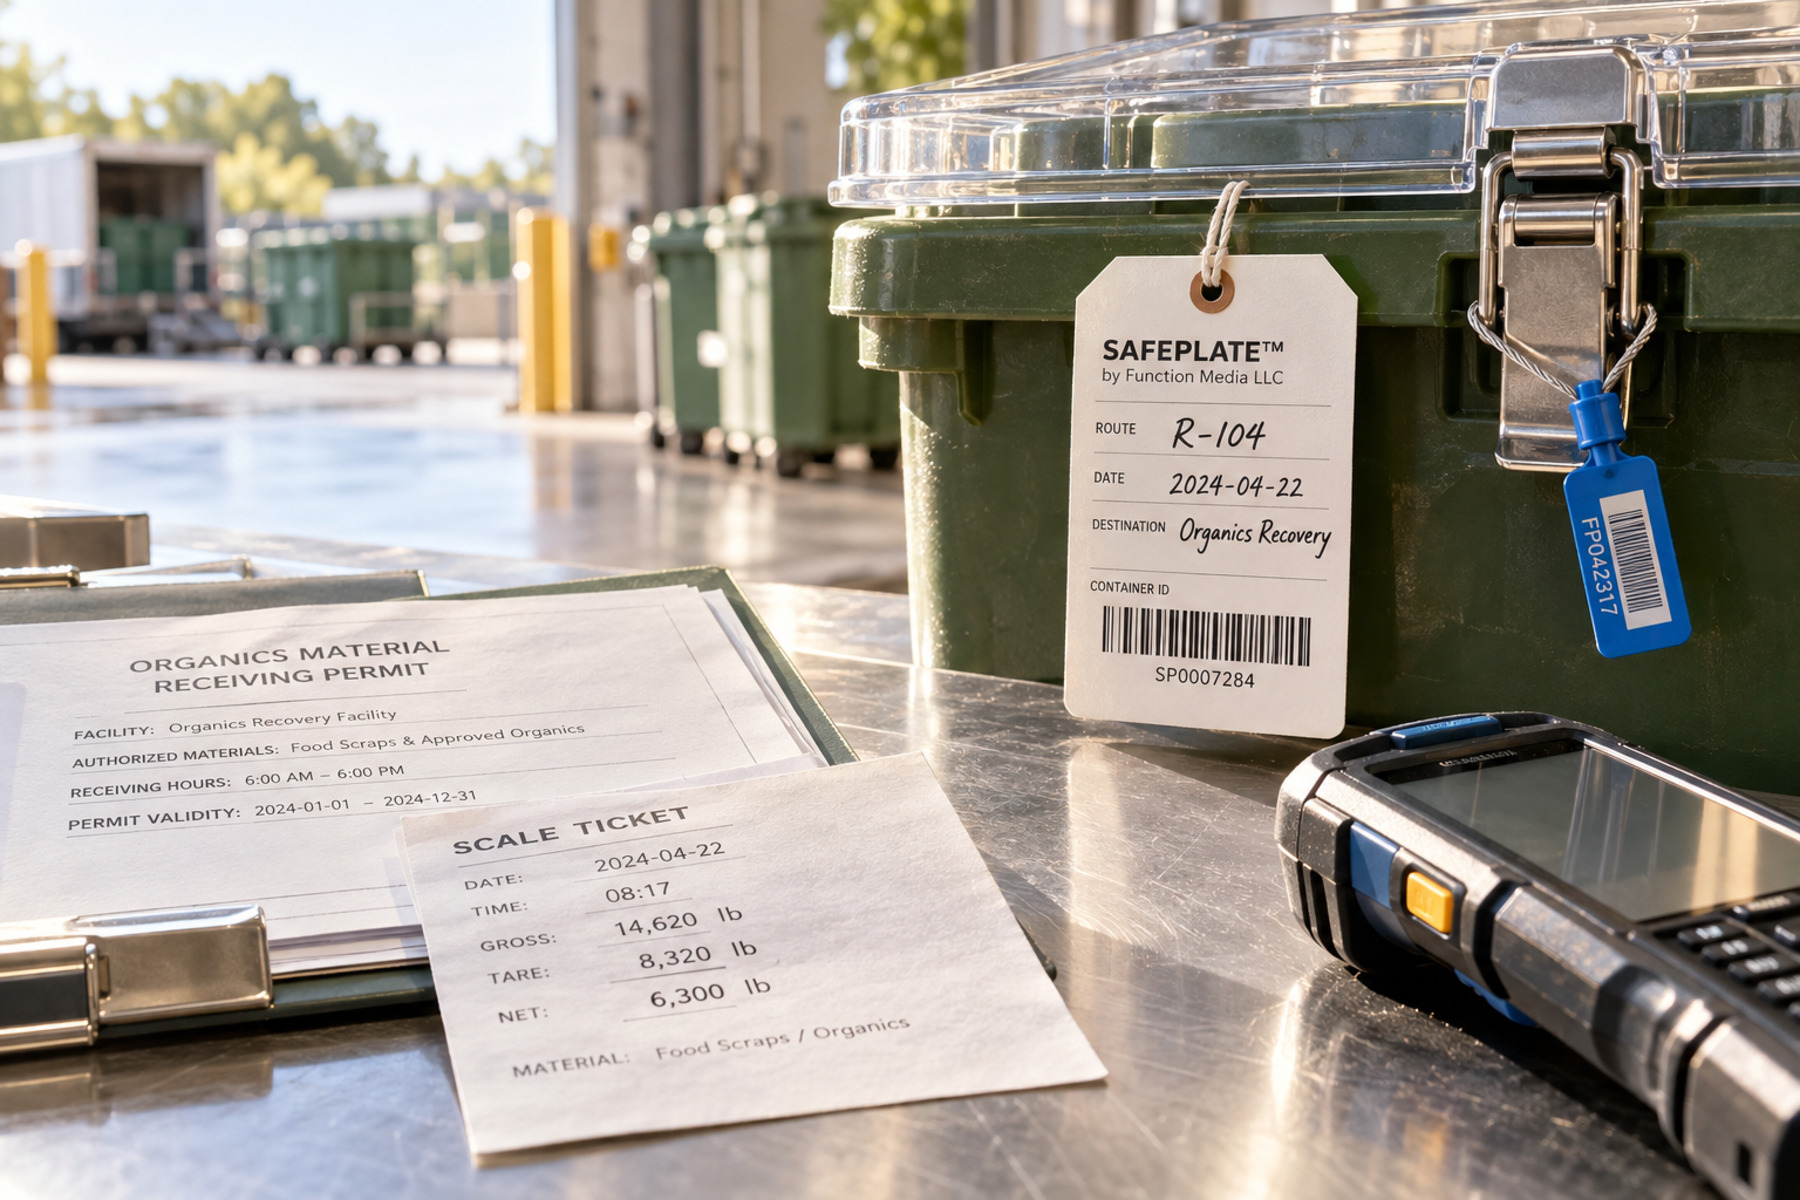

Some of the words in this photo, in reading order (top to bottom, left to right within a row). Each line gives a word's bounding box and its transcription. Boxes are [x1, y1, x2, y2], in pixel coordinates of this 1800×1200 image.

[1102, 368, 1120, 385] by
[1126, 368, 1194, 383] Function
[1200, 370, 1248, 384] Media
[1254, 370, 1283, 385] LLC
[1096, 422, 1136, 435] ROUTE
[1172, 417, 1266, 450] R-104
[1094, 471, 1125, 484] DATE
[1169, 473, 1303, 497] 2024-04-22
[1093, 519, 1165, 532] DESTINATION
[1180, 518, 1253, 554] Organics
[1258, 519, 1332, 559] Recovery
[1582, 517, 1618, 615] FP042317
[1090, 580, 1154, 594] CONTAINER
[1159, 584, 1169, 595] ID
[130, 649, 288, 673] ORGANICS
[300, 640, 450, 660] MATERIAL
[155, 670, 313, 693] RECEIVING
[323, 662, 429, 681] PERMIT
[1155, 667, 1255, 688] SP0007284
[75, 726, 154, 740] FACILITY:
[169, 720, 246, 734] Organics
[252, 713, 331, 727] Recovery
[337, 710, 396, 721] Facility
[72, 752, 177, 768] AUTHORIZED
[184, 745, 278, 760] MATERIALS:
[291, 740, 333, 752] Food
[340, 739, 396, 750] Scraps
[403, 736, 415, 745] &
[422, 729, 504, 746] Approved
[511, 725, 584, 739] Organics
[71, 782, 161, 798] RECEIVING
[168, 778, 231, 793] HOURS:
[245, 773, 280, 785] 6:00
[287, 771, 313, 783] AM
[338, 767, 372, 778] 6:00
[378, 765, 404, 776] PM
[69, 815, 141, 833] PERMIT
[147, 808, 240, 824] VALIDITY:
[255, 799, 348, 816] 2024-01-01
[384, 790, 475, 806] 2024-12-31
[453, 826, 559, 854] SCALE
[573, 806, 689, 835] TICKET
[465, 874, 522, 890] DATE:
[595, 842, 725, 872] 2024-04-22
[471, 902, 527, 917] TIME:
[606, 881, 669, 903] 08:17
[480, 934, 556, 952] GROSS:
[615, 913, 698, 936] 14,620
[718, 907, 742, 922] lb
[488, 967, 549, 984] TARE:
[639, 946, 712, 972] 8,320
[731, 941, 757, 957] lb
[498, 1007, 547, 1023] NET:
[650, 984, 724, 1008] 6,300
[745, 978, 770, 995] lb
[513, 1053, 629, 1077] MATERIAL:
[656, 1042, 710, 1059] Food
[717, 1032, 791, 1051] Scraps
[798, 1029, 805, 1043] /
[813, 1016, 910, 1040] Organics
